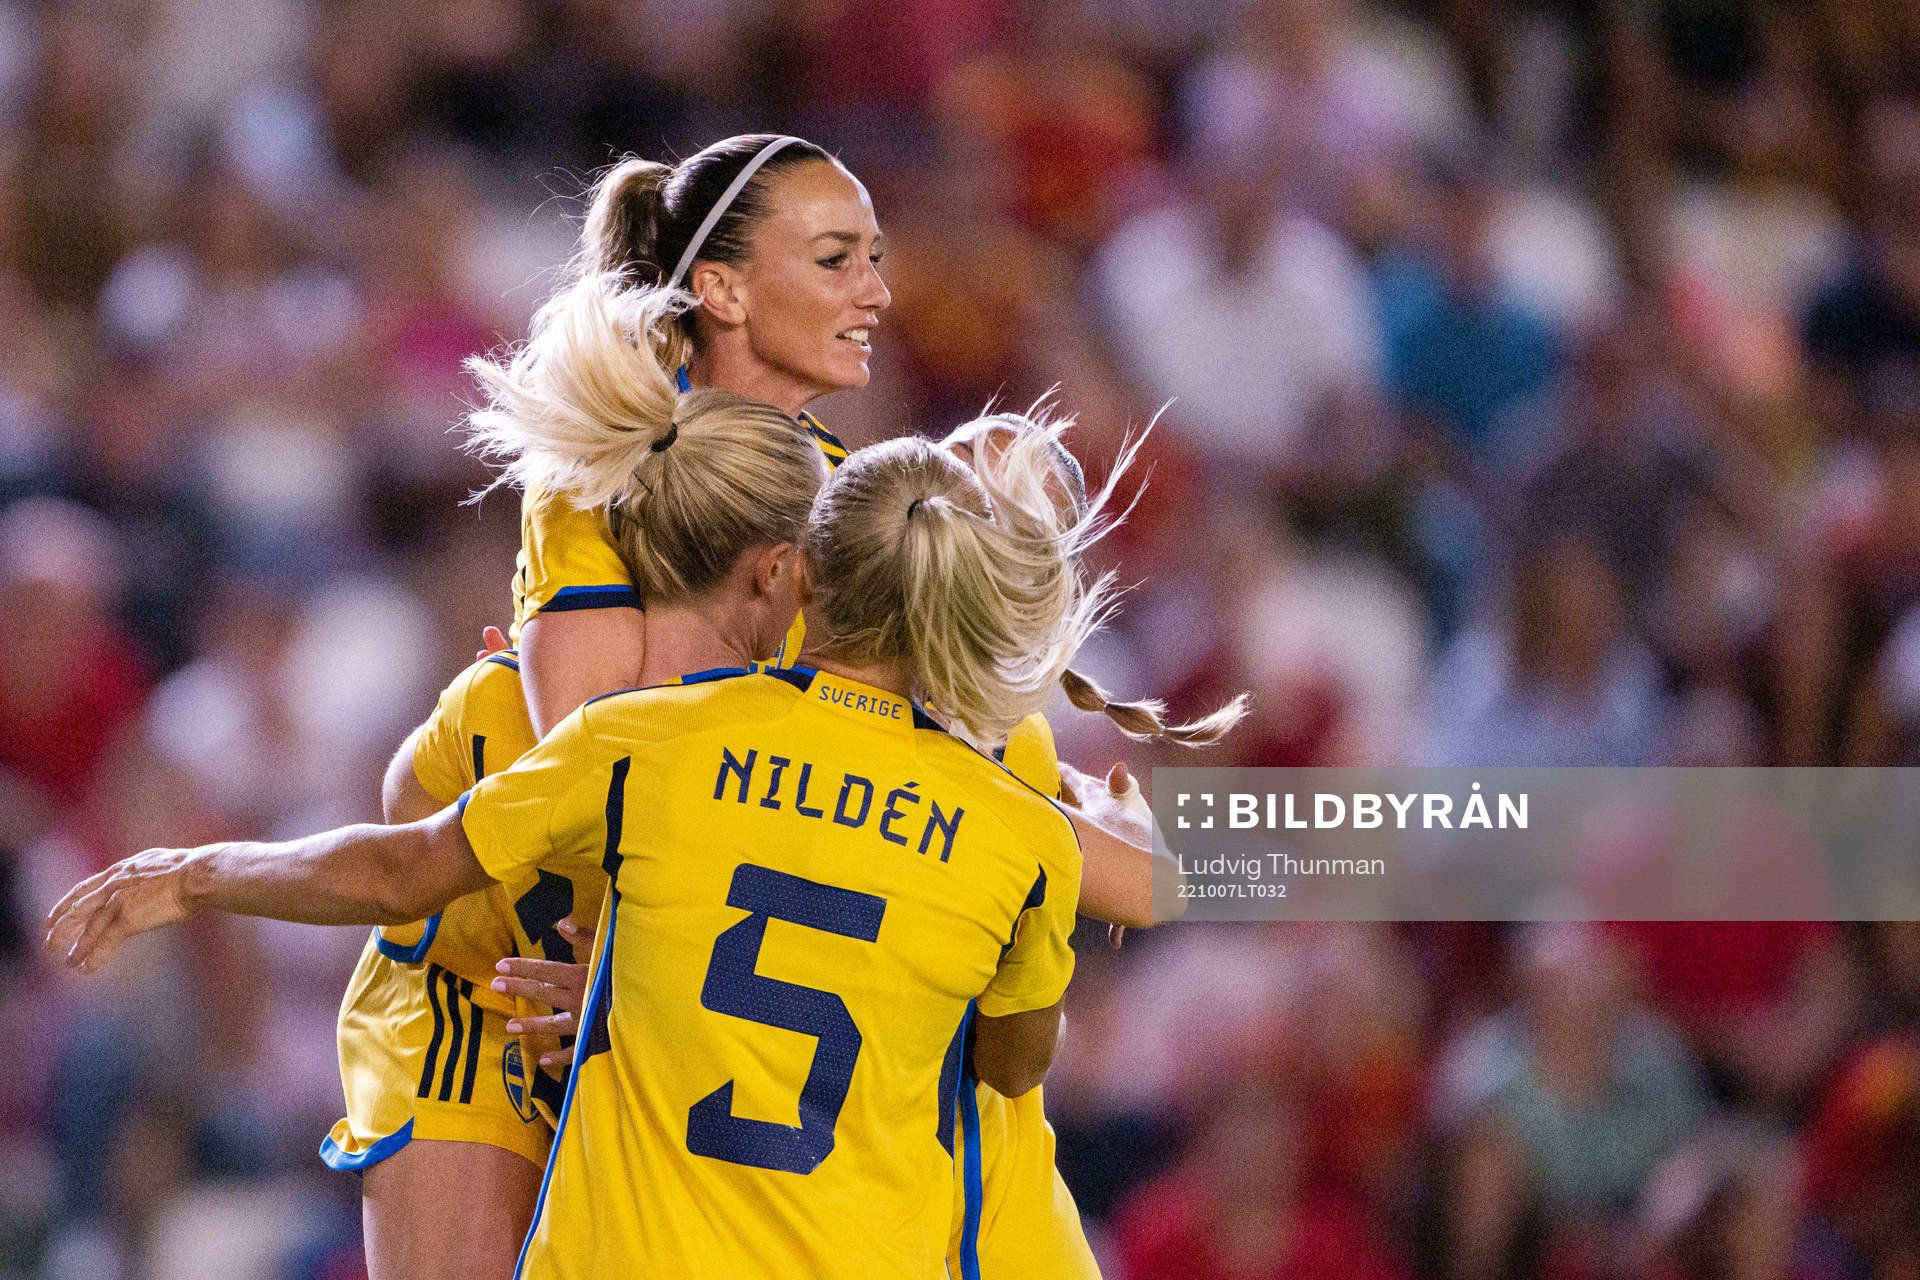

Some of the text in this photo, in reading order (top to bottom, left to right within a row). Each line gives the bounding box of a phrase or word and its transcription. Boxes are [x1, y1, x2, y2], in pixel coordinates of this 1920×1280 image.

[819, 685, 903, 720] SVERIGE
[713, 746, 965, 863] NILDÉN
[686, 863, 887, 1175] 5
